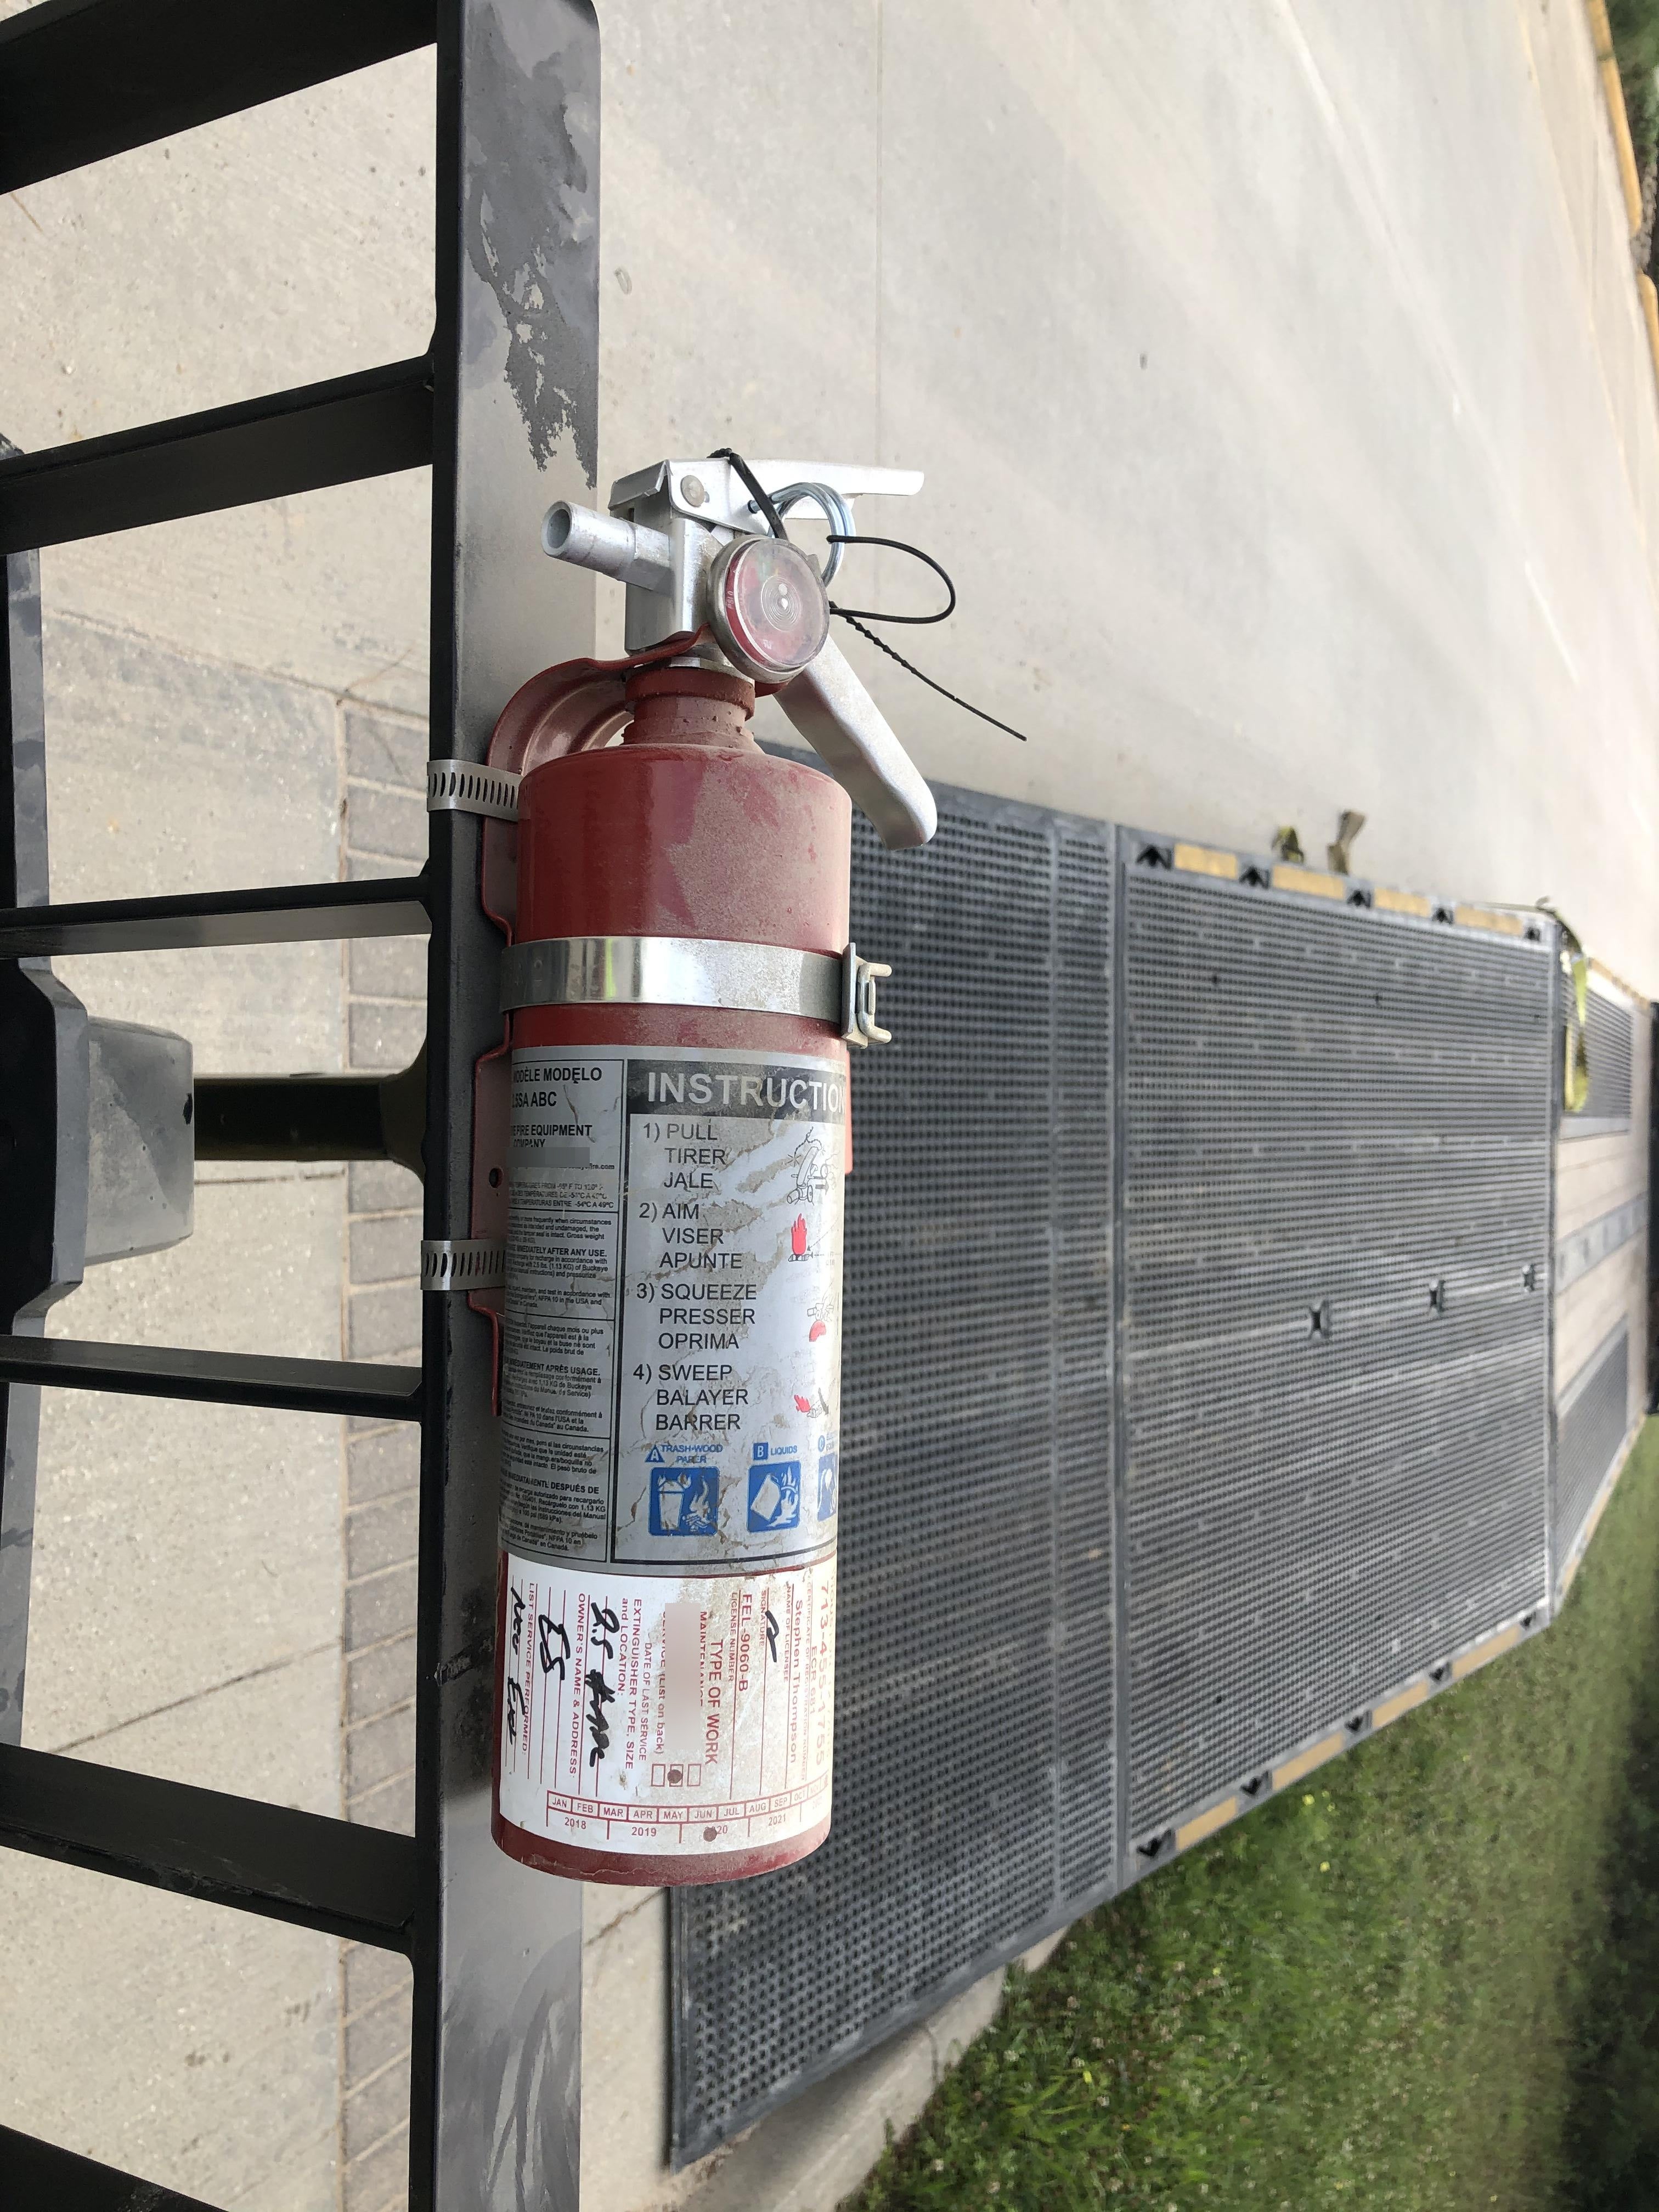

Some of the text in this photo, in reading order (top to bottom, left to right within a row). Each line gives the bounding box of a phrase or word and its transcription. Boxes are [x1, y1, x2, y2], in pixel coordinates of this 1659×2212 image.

[544, 1067, 602, 1081] MODELO
[531, 1091, 556, 1107] ABC
[531, 1125, 592, 1136] EQUIPMENT
[644, 1123, 718, 1142] 1) PULL
[665, 1148, 726, 1165] TIRER
[664, 1172, 713, 1189] JALE
[639, 1203, 699, 1223] 2) AIM
[662, 1228, 724, 1244] VISER
[659, 1252, 742, 1268] APUNTE
[636, 1283, 757, 1303] 3) SQUEEZE
[660, 1308, 755, 1324] PRESSER
[658, 1333, 739, 1349] OPRIMA
[571, 1367, 600, 1376] USAGE.
[633, 1364, 732, 1384] 4) SWEEP
[657, 1389, 748, 1406] BALAYER
[656, 1414, 741, 1430] BARRER
[770, 1446, 798, 1456] LIQUIDS
[551, 1482, 585, 1493] DESPUÉS
[575, 1593, 585, 1654] OWNER'S
[786, 1618, 790, 1626] OF
[525, 1613, 534, 1668] SERVICE
[738, 1594, 752, 1691] FEL-9060-B
[617, 1626, 628, 1696] LOCATION:
[573, 1658, 582, 1695] NAME
[625, 1599, 642, 1769] EXTINGUISHER TYPE, SIZE
[791, 1600, 803, 1763] Stephen Thompson
[816, 1585, 829, 1765] 713-455-1755
[639, 1643, 652, 1760] DATE OF LAST SERVICE
[658, 1703, 664, 1718] on
[705, 1639, 723, 1765] TYPE OF WORK
[654, 1723, 665, 1754] back)
[552, 1797, 567, 1808] JAN
[577, 1803, 594, 1813] FEB
[603, 1807, 623, 1817] MAR
[633, 1810, 653, 1819] APR
[664, 1811, 683, 1819] MAY
[695, 1809, 712, 1819] JUN
[724, 1807, 740, 1816] JUL
[749, 1803, 766, 1813] AUG
[774, 1797, 788, 1807] SEP
[794, 1790, 805, 1801] OCT
[565, 1817, 586, 1830] 2018
[631, 1827, 657, 1836] 2019
[768, 1813, 786, 1826] 2021
